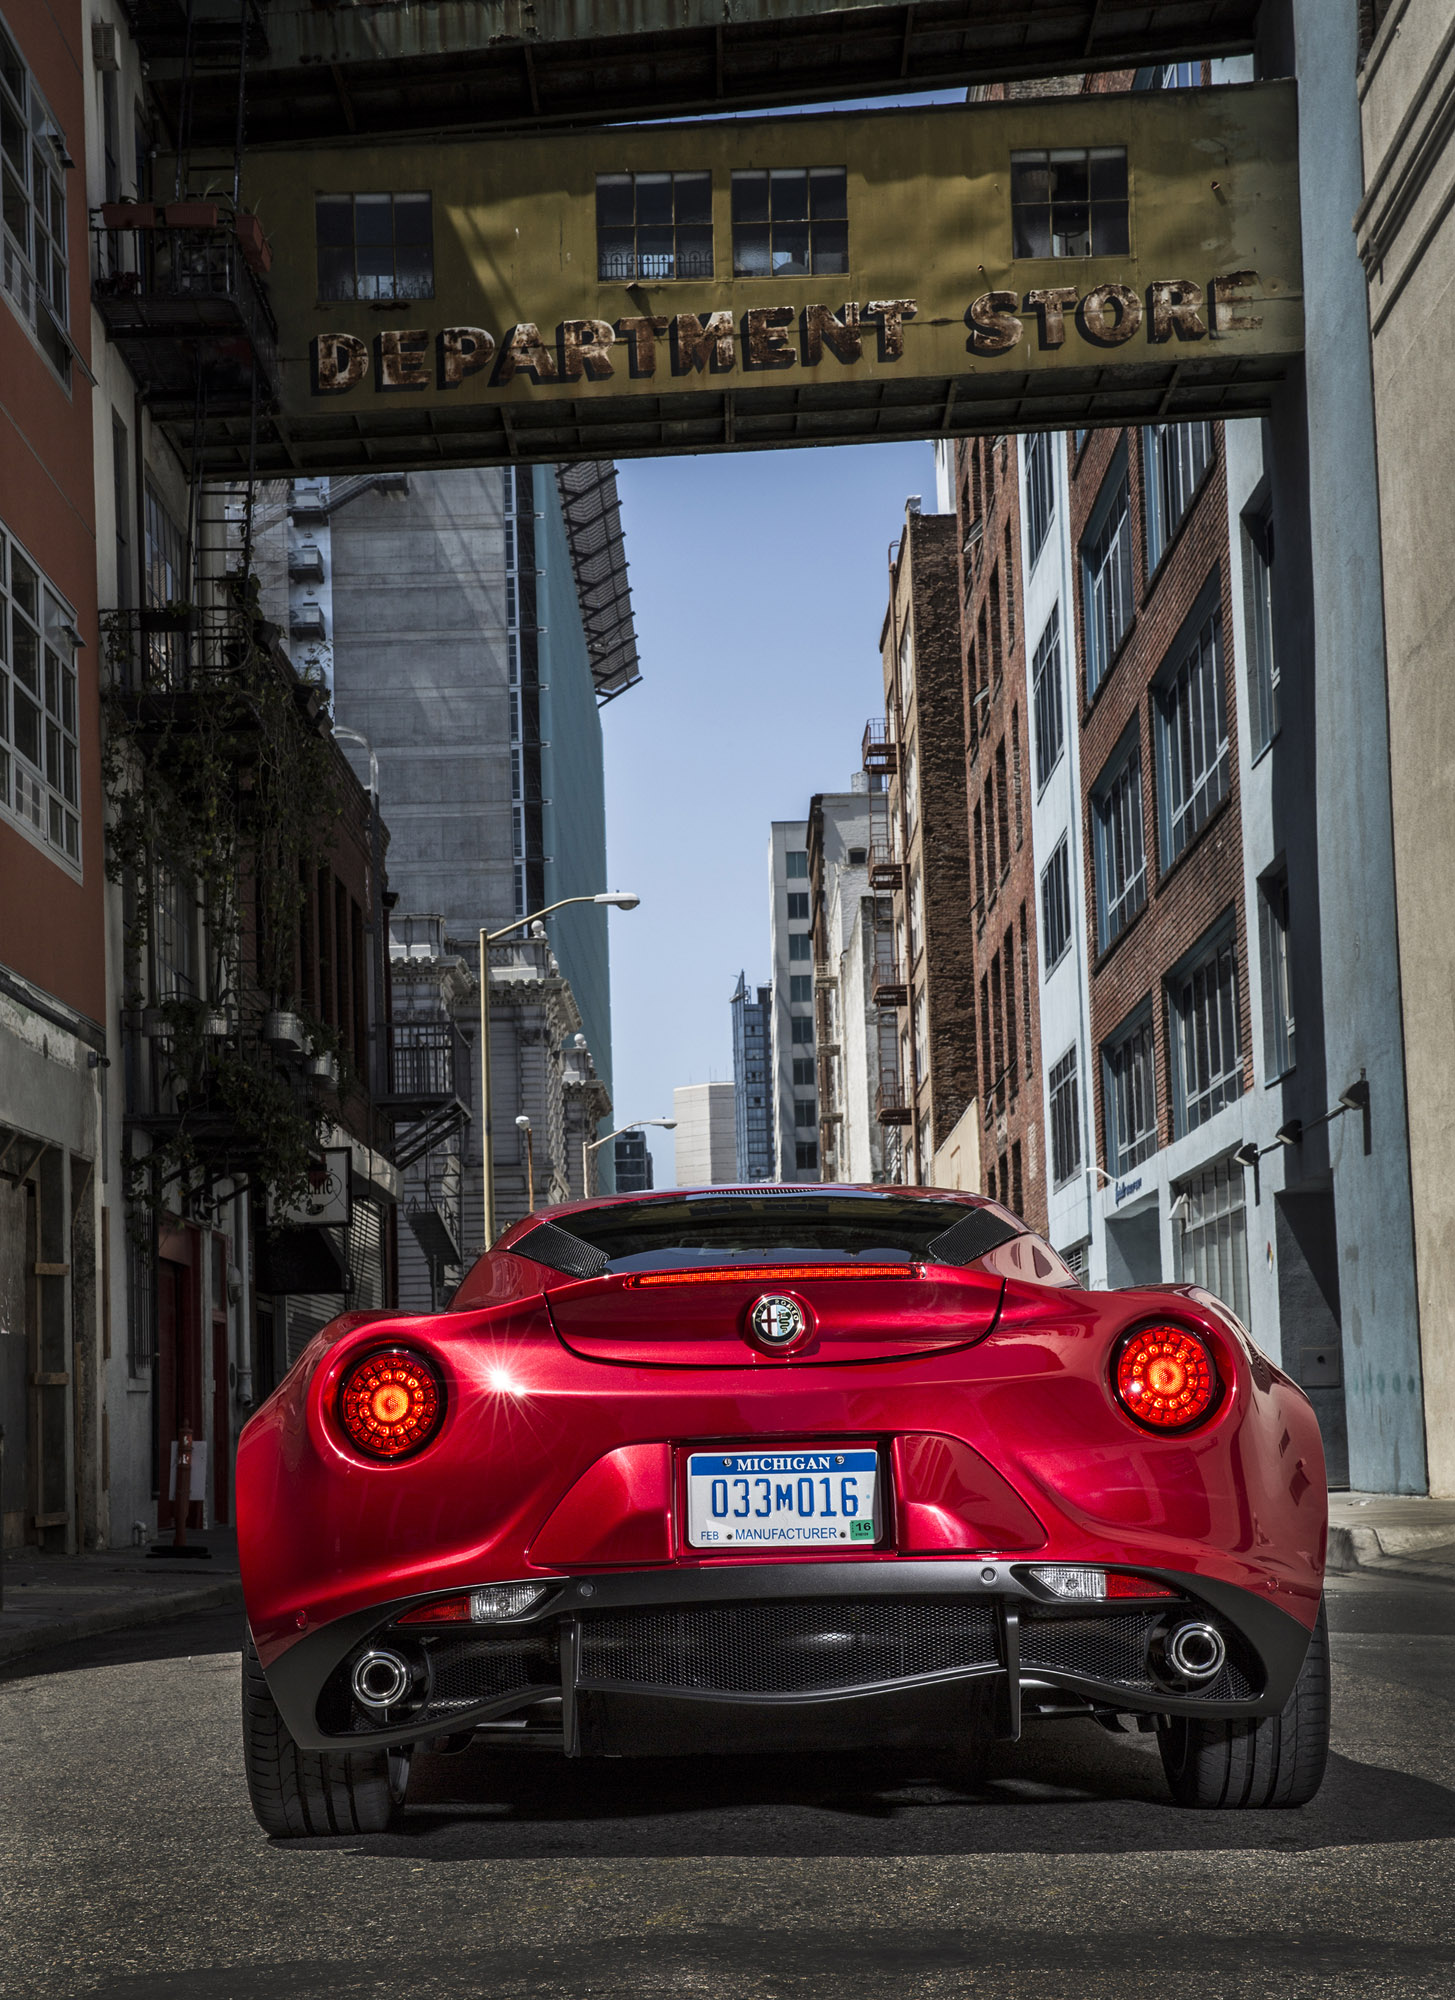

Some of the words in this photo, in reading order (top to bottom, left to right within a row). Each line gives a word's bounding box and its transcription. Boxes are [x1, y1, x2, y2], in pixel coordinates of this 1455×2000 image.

[312, 298, 917, 392] DEPARTMENT
[968, 270, 1263, 353] STORE
[774, 1299, 799, 1321] ROMEO
[736, 1457, 831, 1472] MICHIGAN
[711, 1477, 859, 1518] 033M016
[700, 1530, 720, 1541] FEB
[735, 1527, 838, 1540] MANUFACTURER
[855, 1522, 872, 1532] 16
